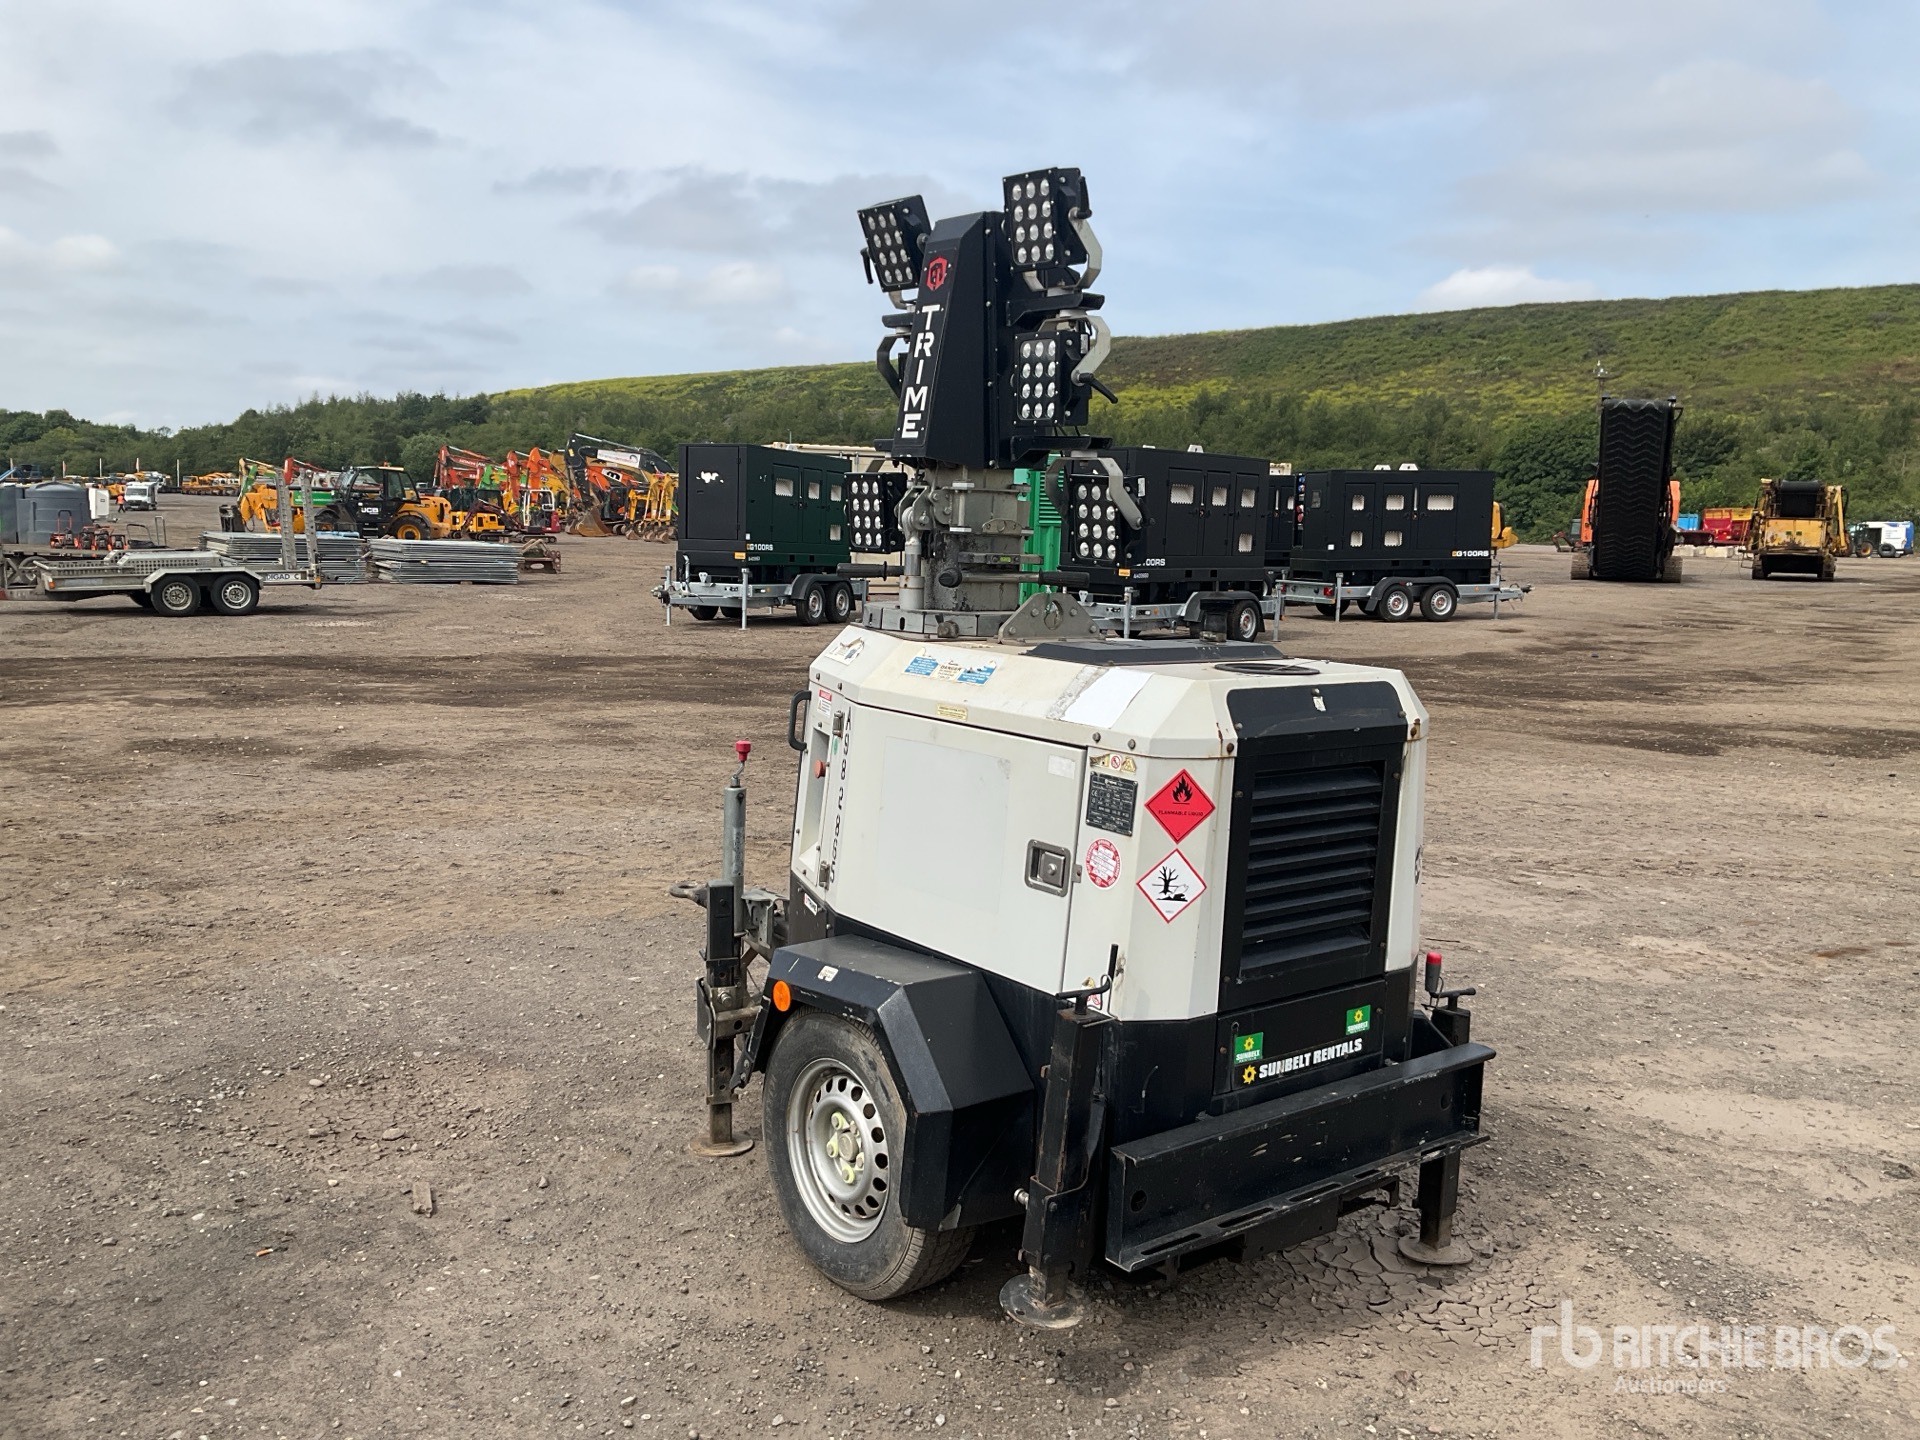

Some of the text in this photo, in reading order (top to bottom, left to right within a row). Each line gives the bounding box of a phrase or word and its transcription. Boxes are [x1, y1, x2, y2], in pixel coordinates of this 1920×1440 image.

[901, 304, 941, 439] TRIME
[1236, 1050, 1260, 1060] SUNBELT
[1259, 1038, 1363, 1079] SUNBELT RENTALS
